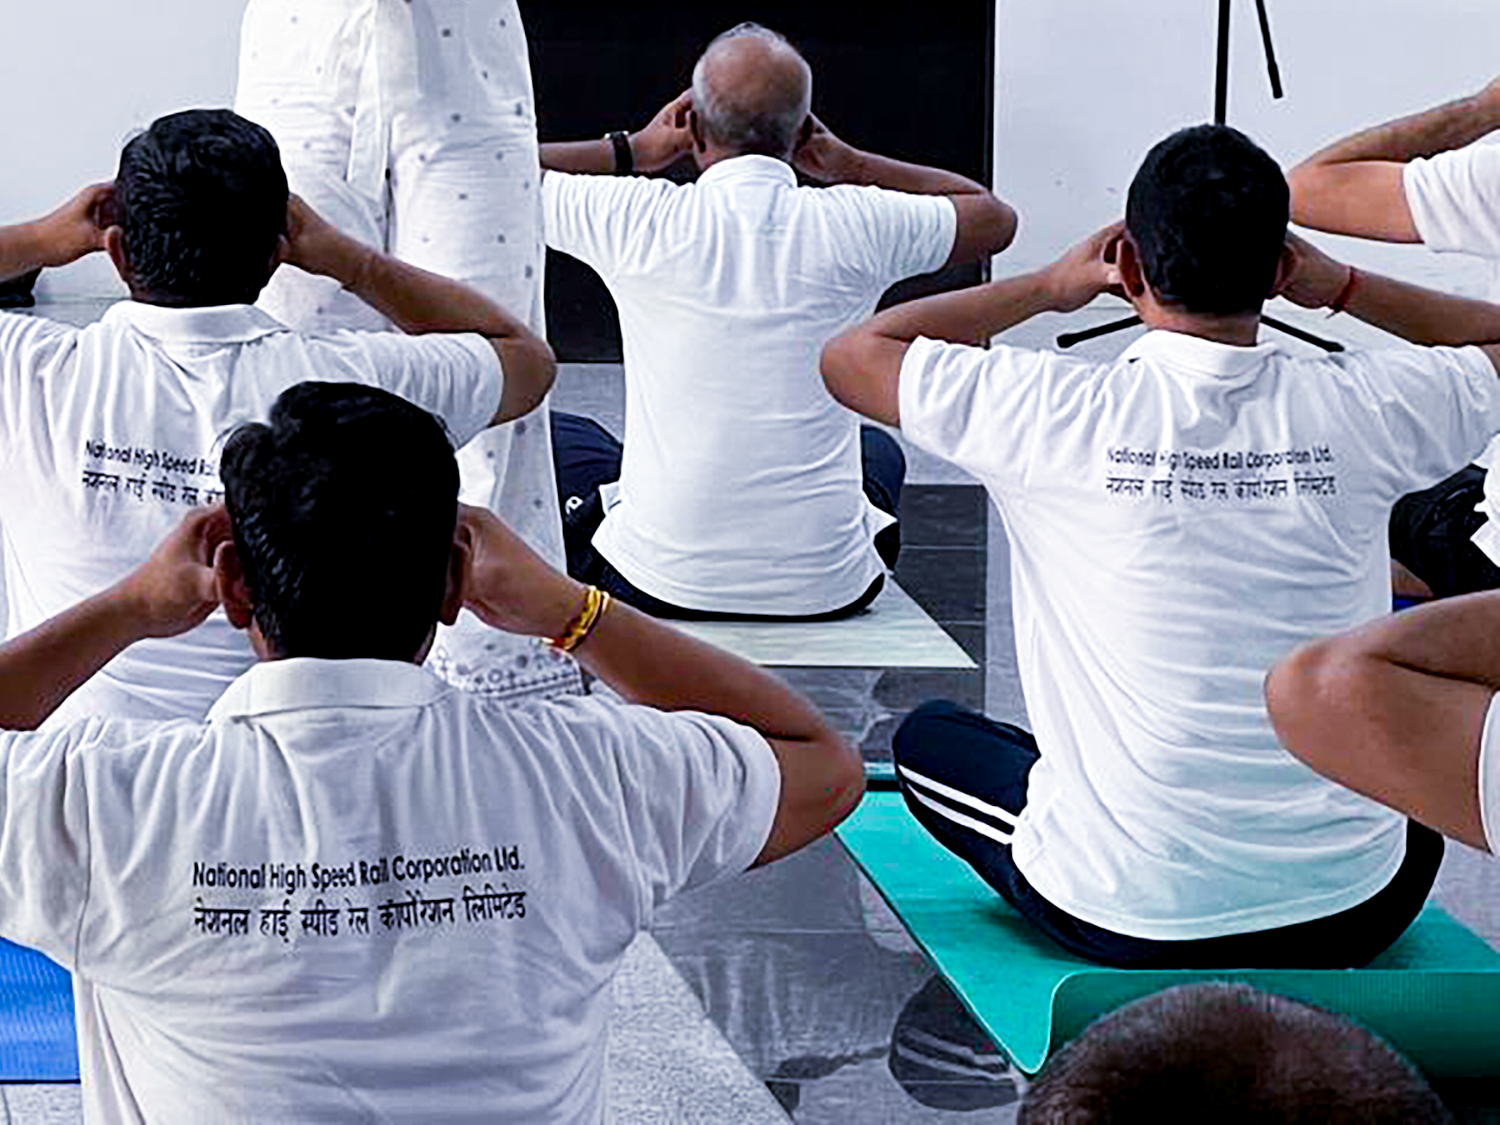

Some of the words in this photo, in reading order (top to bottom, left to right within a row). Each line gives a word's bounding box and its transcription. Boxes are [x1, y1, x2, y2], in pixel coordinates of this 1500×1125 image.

[193, 861, 266, 889] National
[269, 862, 307, 895] High
[311, 861, 356, 893] Speed
[358, 857, 389, 886] Rail
[392, 847, 493, 885] Corporation
[494, 845, 526, 873] Ltd.
[194, 896, 251, 936] नेशनल
[259, 898, 291, 944] हाई
[343, 896, 370, 935] रेल
[462, 882, 527, 923] लिमिटेड
